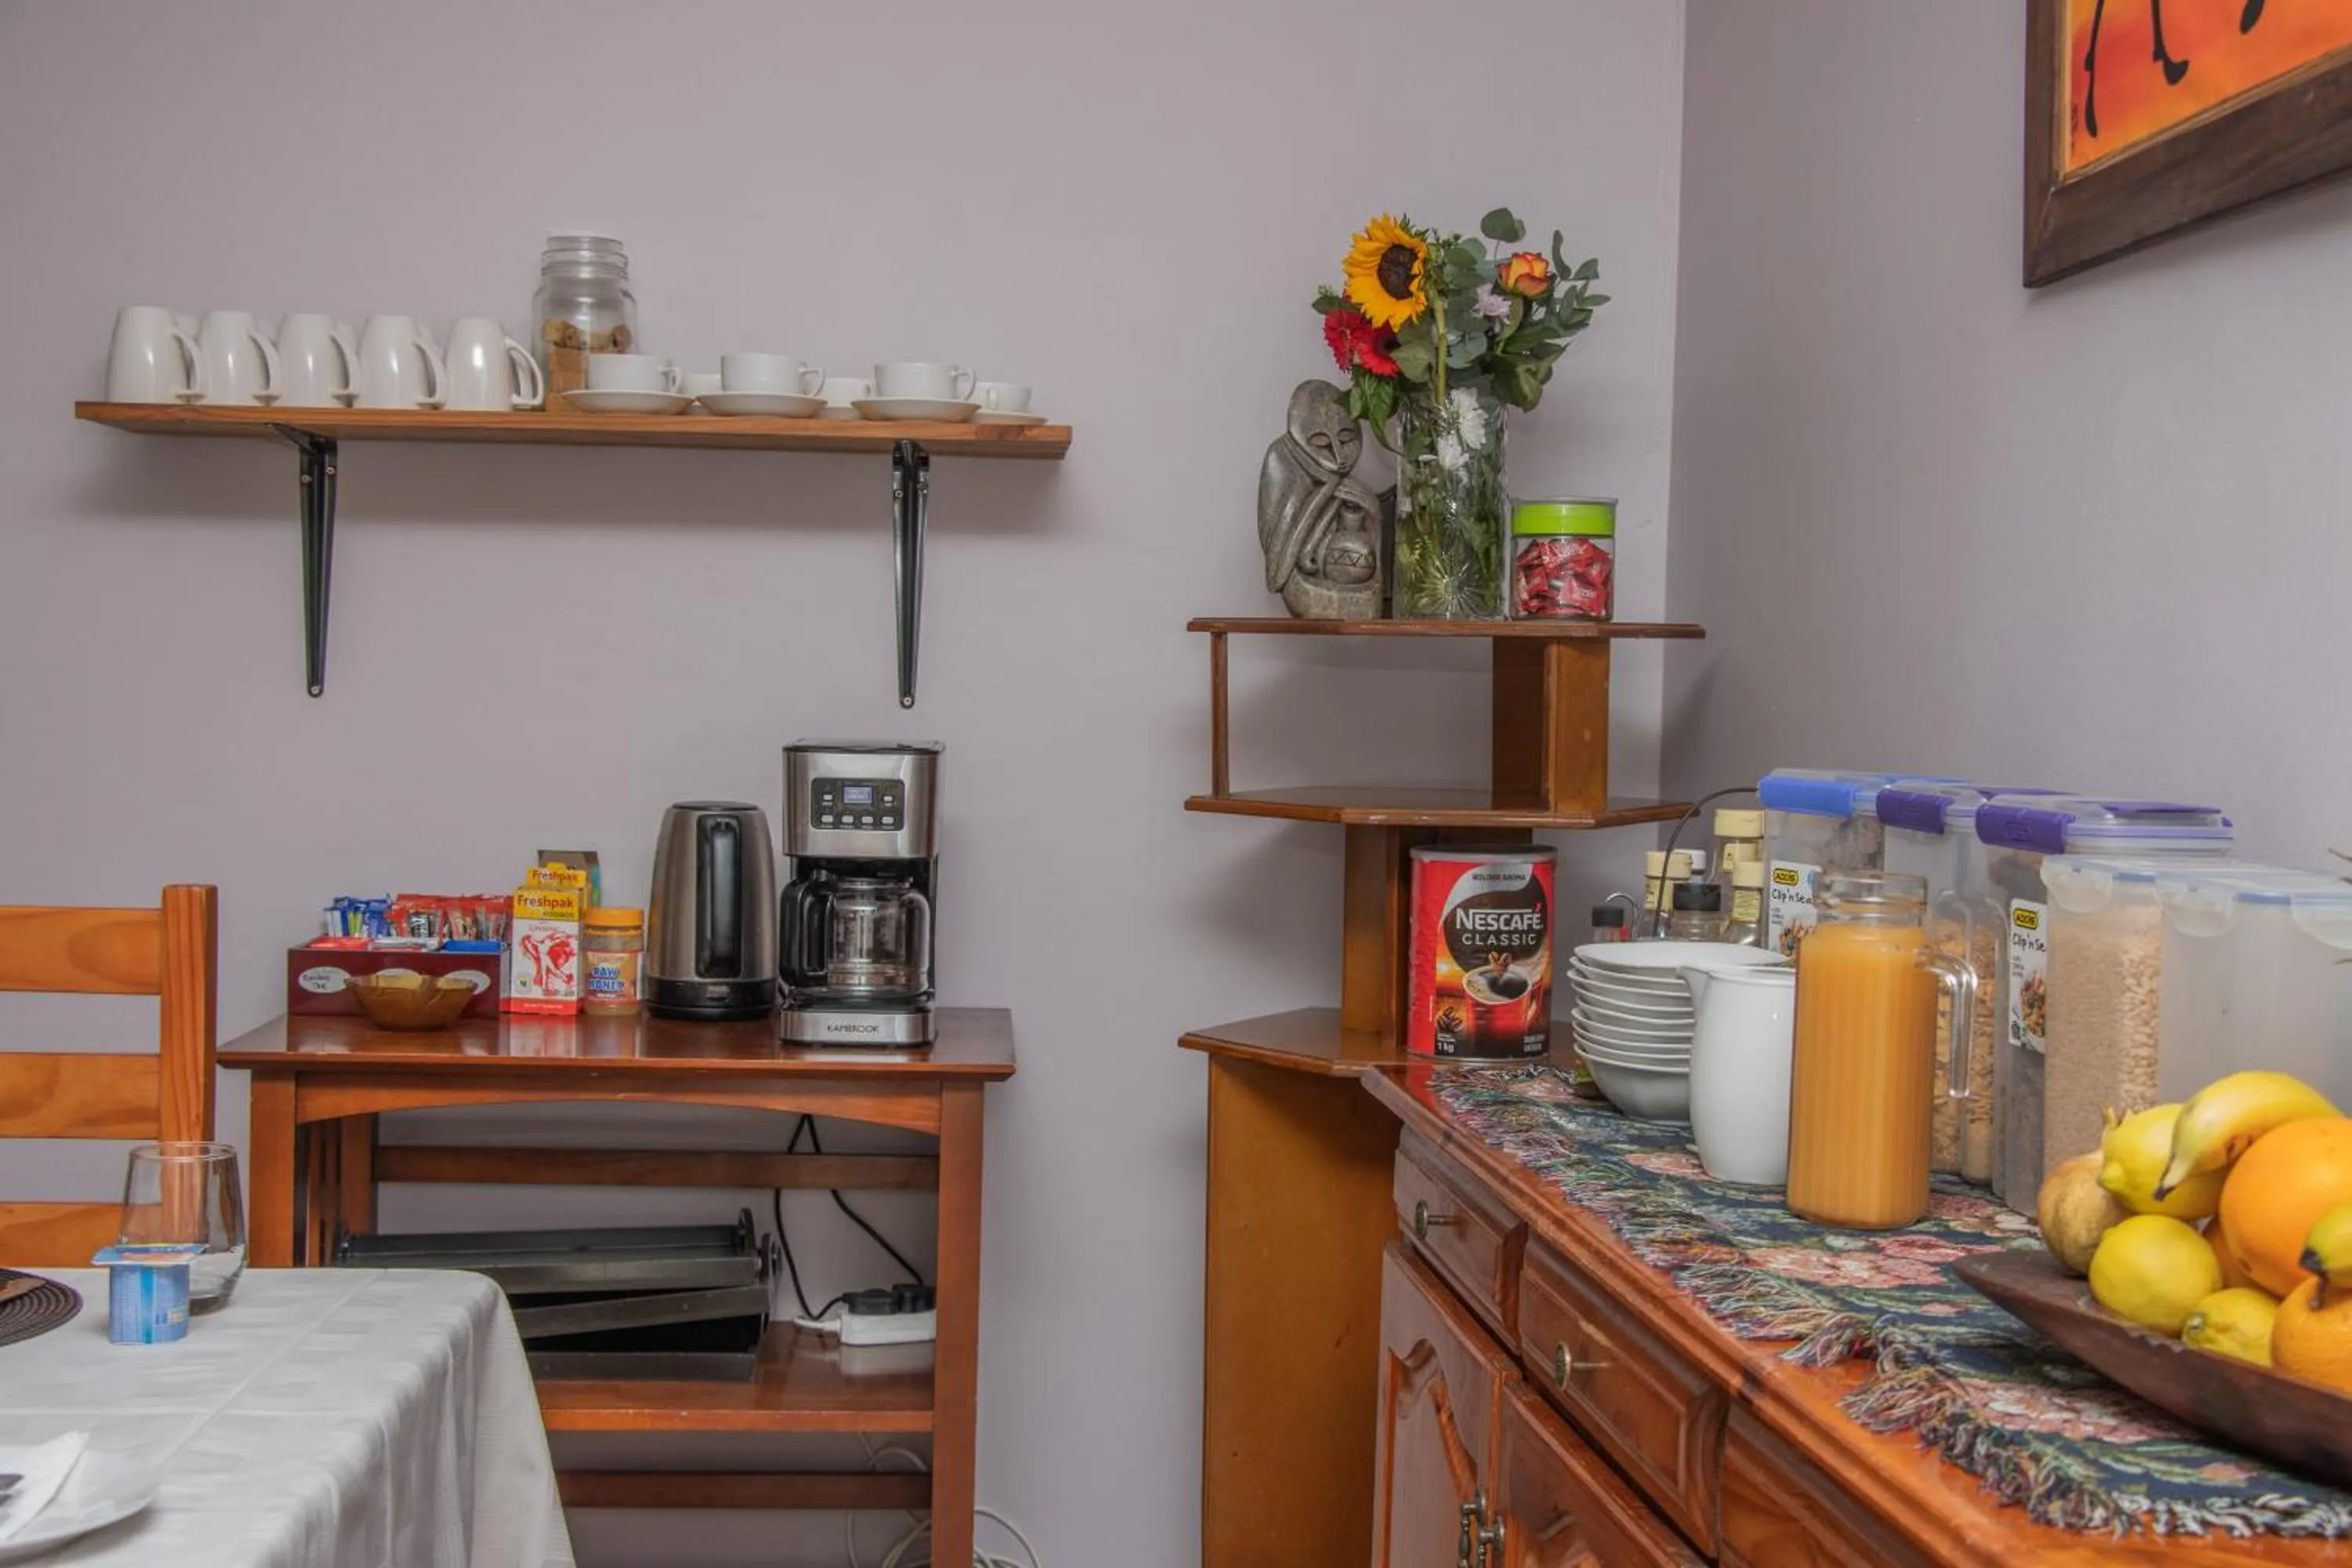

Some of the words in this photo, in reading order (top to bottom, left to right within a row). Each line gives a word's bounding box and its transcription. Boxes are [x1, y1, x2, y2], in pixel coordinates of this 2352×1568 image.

[532, 869, 578, 884] Freshpak
[517, 895, 574, 909] Freshpak
[1795, 891, 1812, 904] Sea
[1456, 902, 1542, 931] NESCAFÉ
[1461, 933, 1537, 946] CLASSIC
[2034, 938, 2046, 953] Se
[592, 966, 618, 978] RAW
[589, 980, 625, 992] HONEY
[1443, 1042, 1455, 1054] kg
